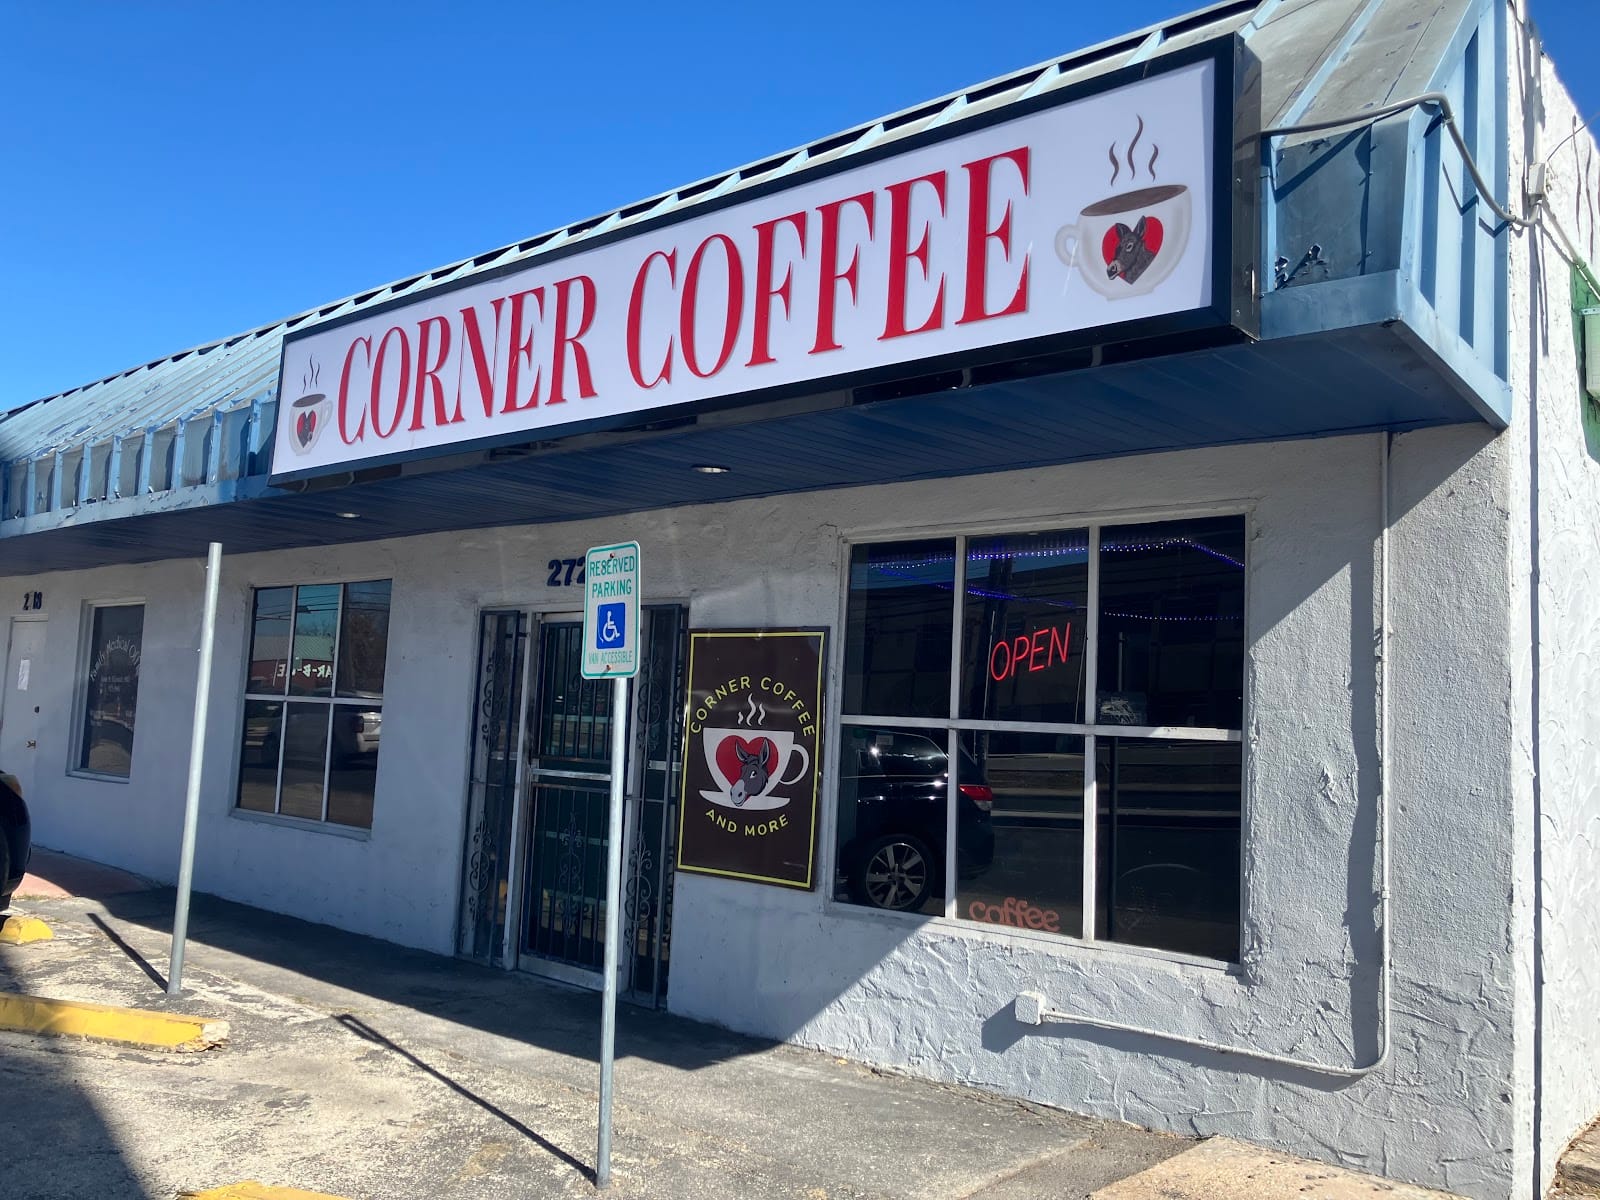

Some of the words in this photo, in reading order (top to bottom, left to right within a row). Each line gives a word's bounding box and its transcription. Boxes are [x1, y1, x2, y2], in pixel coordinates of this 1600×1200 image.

[338, 275, 598, 446] CORNER
[626, 146, 1030, 390] COFFEE
[589, 555, 635, 577] RESERVED
[592, 578, 632, 598] PARKING
[601, 650, 632, 664] ACCESSIBLE
[990, 622, 1071, 681] OPEN
[690, 676, 751, 734] CORNER
[760, 676, 816, 737] COFFEE
[705, 808, 737, 833] AND
[744, 813, 789, 837] MORE
[969, 897, 1060, 932] coffee
